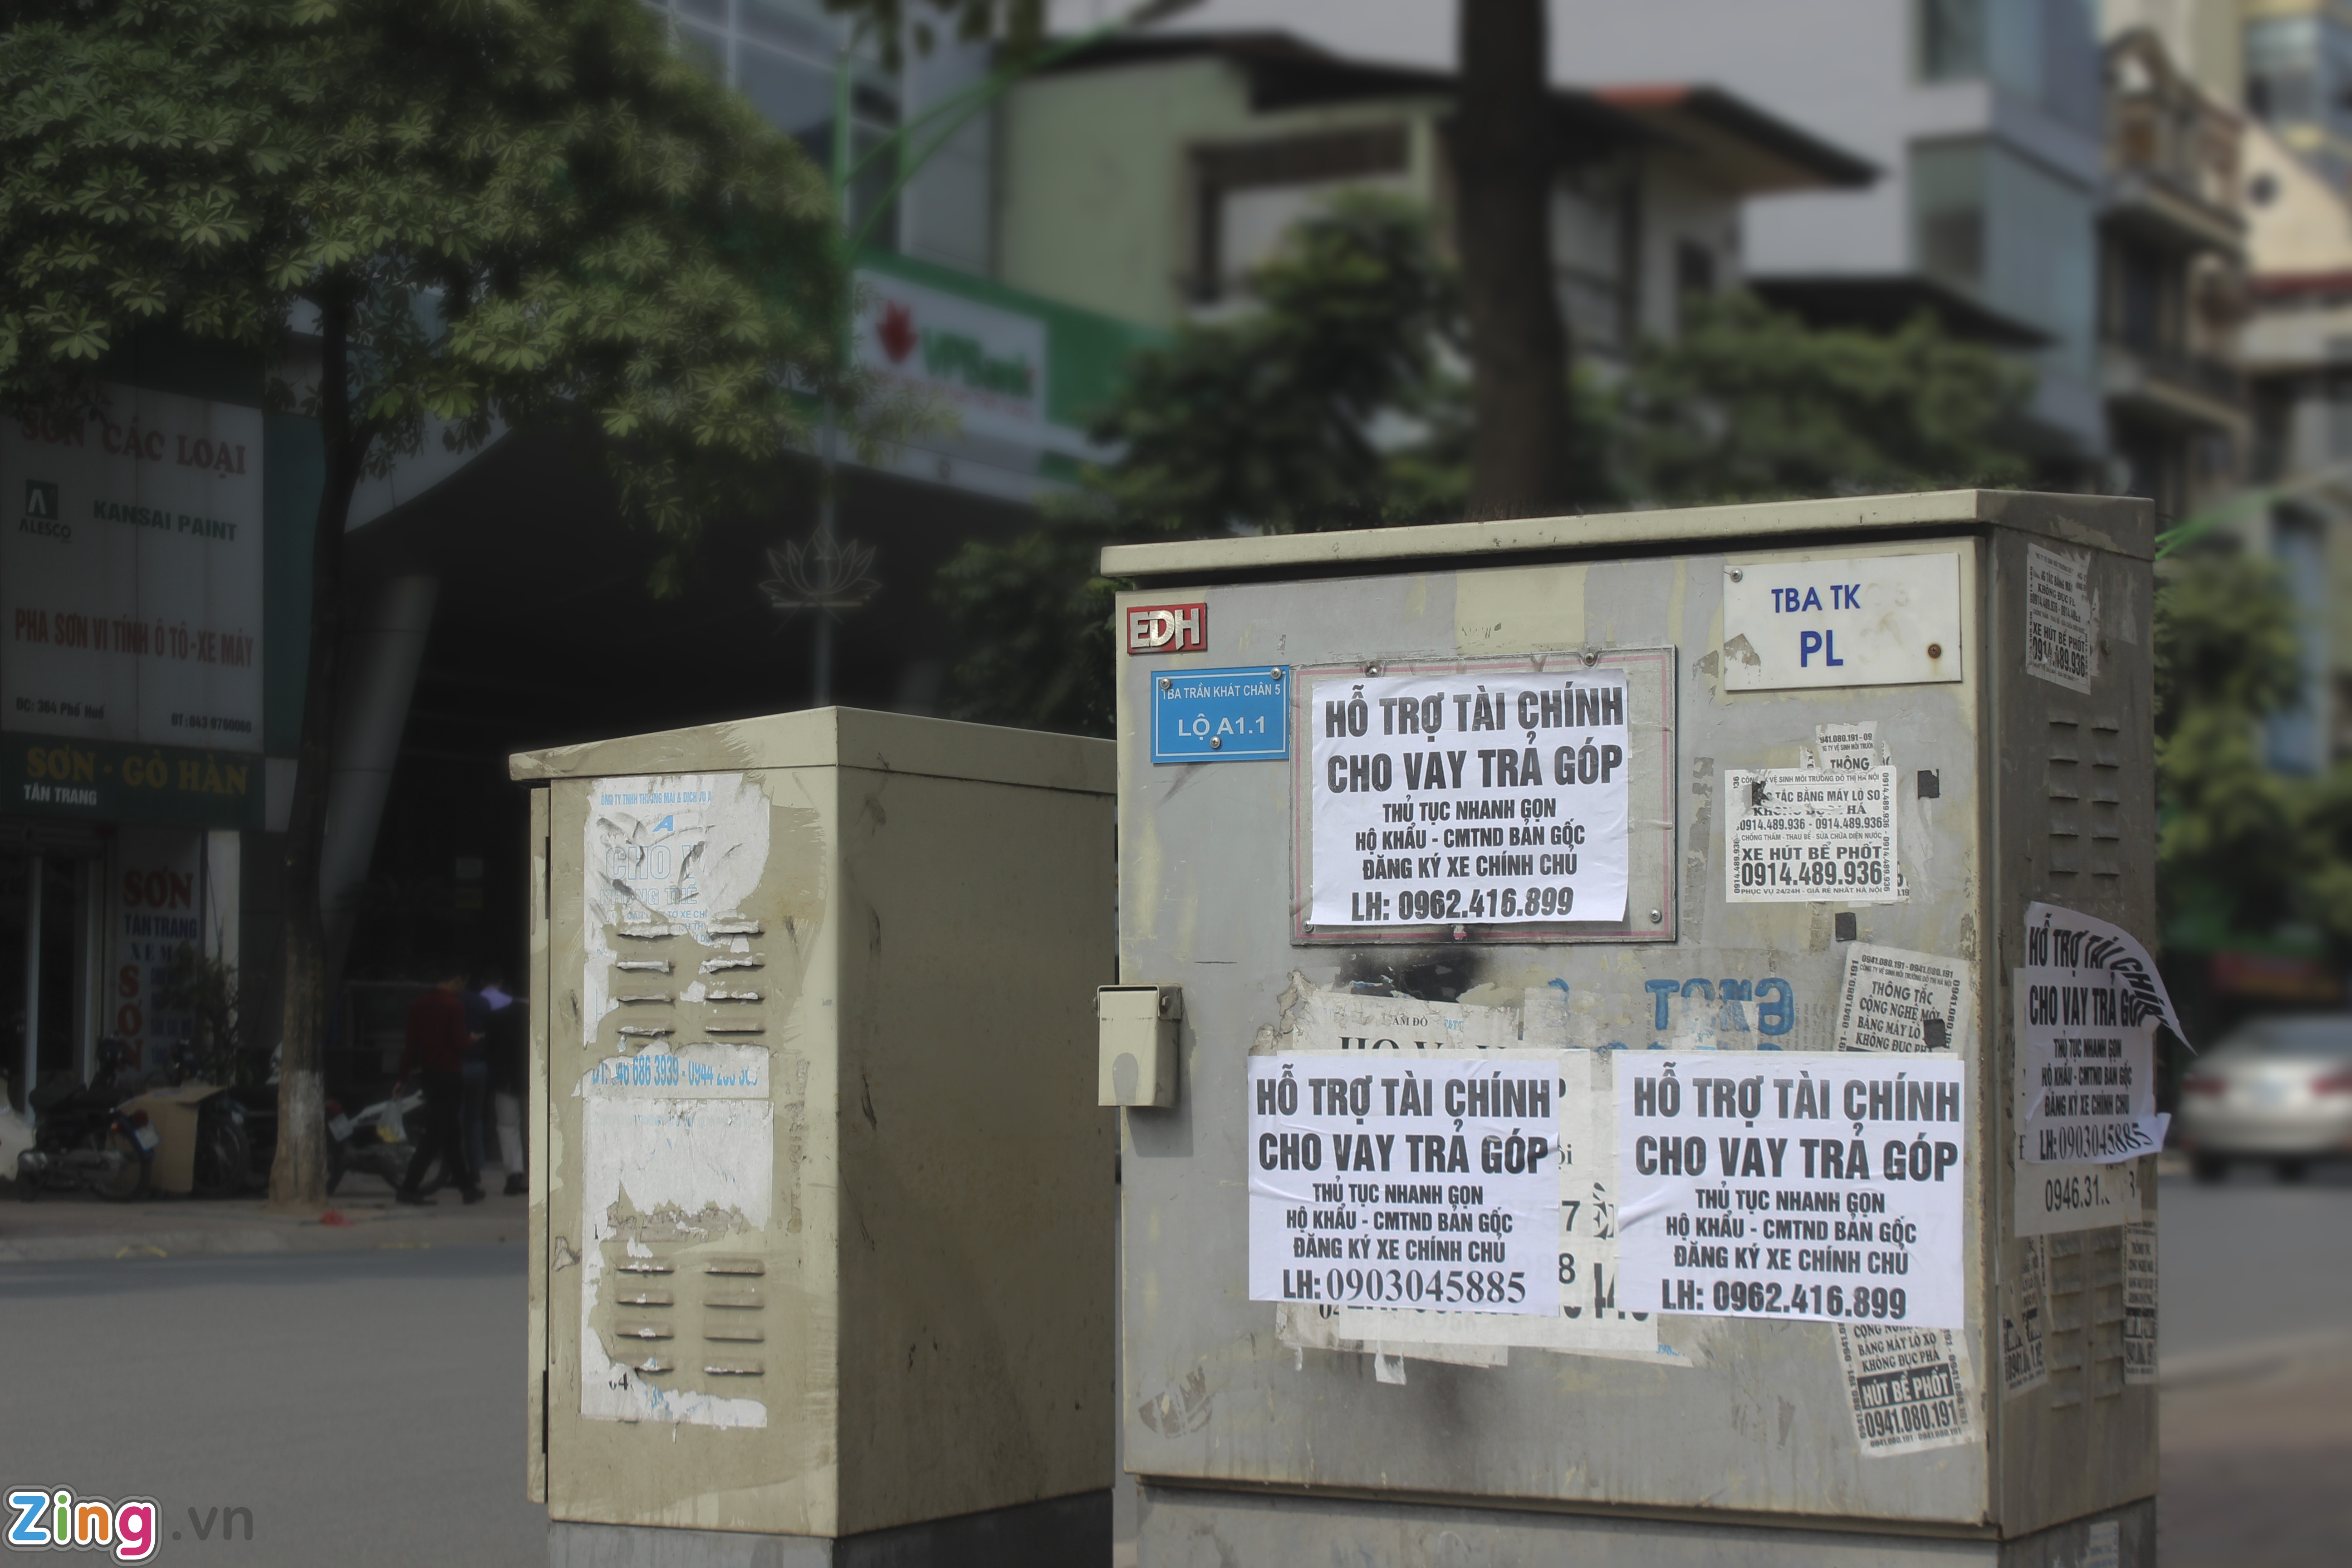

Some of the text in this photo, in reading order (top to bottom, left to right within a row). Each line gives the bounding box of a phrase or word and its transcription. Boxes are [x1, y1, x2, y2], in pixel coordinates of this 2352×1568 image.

[102, 416, 165, 461] CÁC
[176, 434, 246, 479] LOẠI
[19, 519, 71, 539] ALESCO
[93, 500, 237, 541] KANSAI PAINT
[1771, 583, 1861, 613] TBA TK
[15, 608, 49, 643] PHA
[54, 612, 88, 648] SƠN
[93, 617, 108, 651] VI
[113, 614, 149, 656] TÍNH
[154, 618, 165, 657] Ô
[221, 628, 254, 667] MÁY
[1130, 608, 1200, 650] EDH
[1800, 630, 1844, 667] PL
[1161, 682, 1280, 700] TBA TRẦN KHÁT CHÂN 5
[84, 704, 105, 720] Huế
[1178, 713, 1265, 740] LỘ A1.1
[1325, 681, 1624, 743] HỖ TRỢ TÀI CHÍNH
[27, 744, 249, 795] SƠN GÒ HÀN
[1327, 731, 1623, 793] CHO VAY TRẢ GÓP
[1830, 755, 1870, 770] THÔNG
[24, 783, 97, 806] TÂN TRANG
[614, 791, 697, 806] TY TNHH MẠI & DỊCH
[1382, 794, 1556, 825] THỦ TỤC NHANH GỌN
[1797, 787, 1880, 802] BẰNG MÁY LÒ SO
[1355, 818, 1585, 855] HỘ KHẨU CMTND BẢN GỐC
[1740, 817, 1882, 831] 0914.489.936 0914.489.936
[606, 845, 671, 880] CHO
[1362, 844, 1578, 880] ĐĂNG KÝ XE CHÍNH CHỦ
[1742, 841, 1882, 861] XE HÚT BỂ PHỐT
[123, 865, 194, 910] SƠN
[1742, 861, 1882, 886] 0914.489.936
[1351, 887, 1574, 921] LH: 0962.416.899
[153, 916, 197, 939] TRANG
[2029, 913, 2090, 977] HỖ TRỢ
[1862, 954, 1905, 970] 0941.080.191
[1872, 980, 1934, 1005] THÔNG TẮC
[2029, 975, 2117, 1026] CHO VAY TRẢ
[633, 1055, 679, 1086] 686 3939
[1256, 1063, 1551, 1125] HỖ TRỢ TÀI CHÍNH
[1634, 1062, 1960, 1127] HỖ TRỢ TÀI CHÍNH
[1259, 1118, 1548, 1174] CHO VAY TRẢ GÓP
[1636, 1122, 1958, 1182] CHO VAY TRẢ GÓP
[2040, 1122, 2154, 1160] LH: 0903045885
[1312, 1175, 1484, 1209] THỦ TỤC NHANH GỌN
[1695, 1181, 1885, 1216] THỦ TỤC NHANH GỌN
[1286, 1204, 1513, 1234] HỘ KHẨU CMTND BẢN GỐC
[1666, 1210, 1917, 1244] HỘ KHẨU CMTND BẢN GỐC
[1294, 1232, 1505, 1263] ĐĂNG KÝ XE CHÍNH CHỦ
[1674, 1240, 1908, 1275] ĐĂNG KÝ XE CHÍNH CHỦ
[1283, 1268, 1527, 1304] LH: 0903045885
[1662, 1279, 1907, 1319] LH: 0962.416.899
[1861, 1366, 1950, 1408] HÚT BỂ PHỐT
[1864, 1398, 1958, 1437] 0941.080.191
